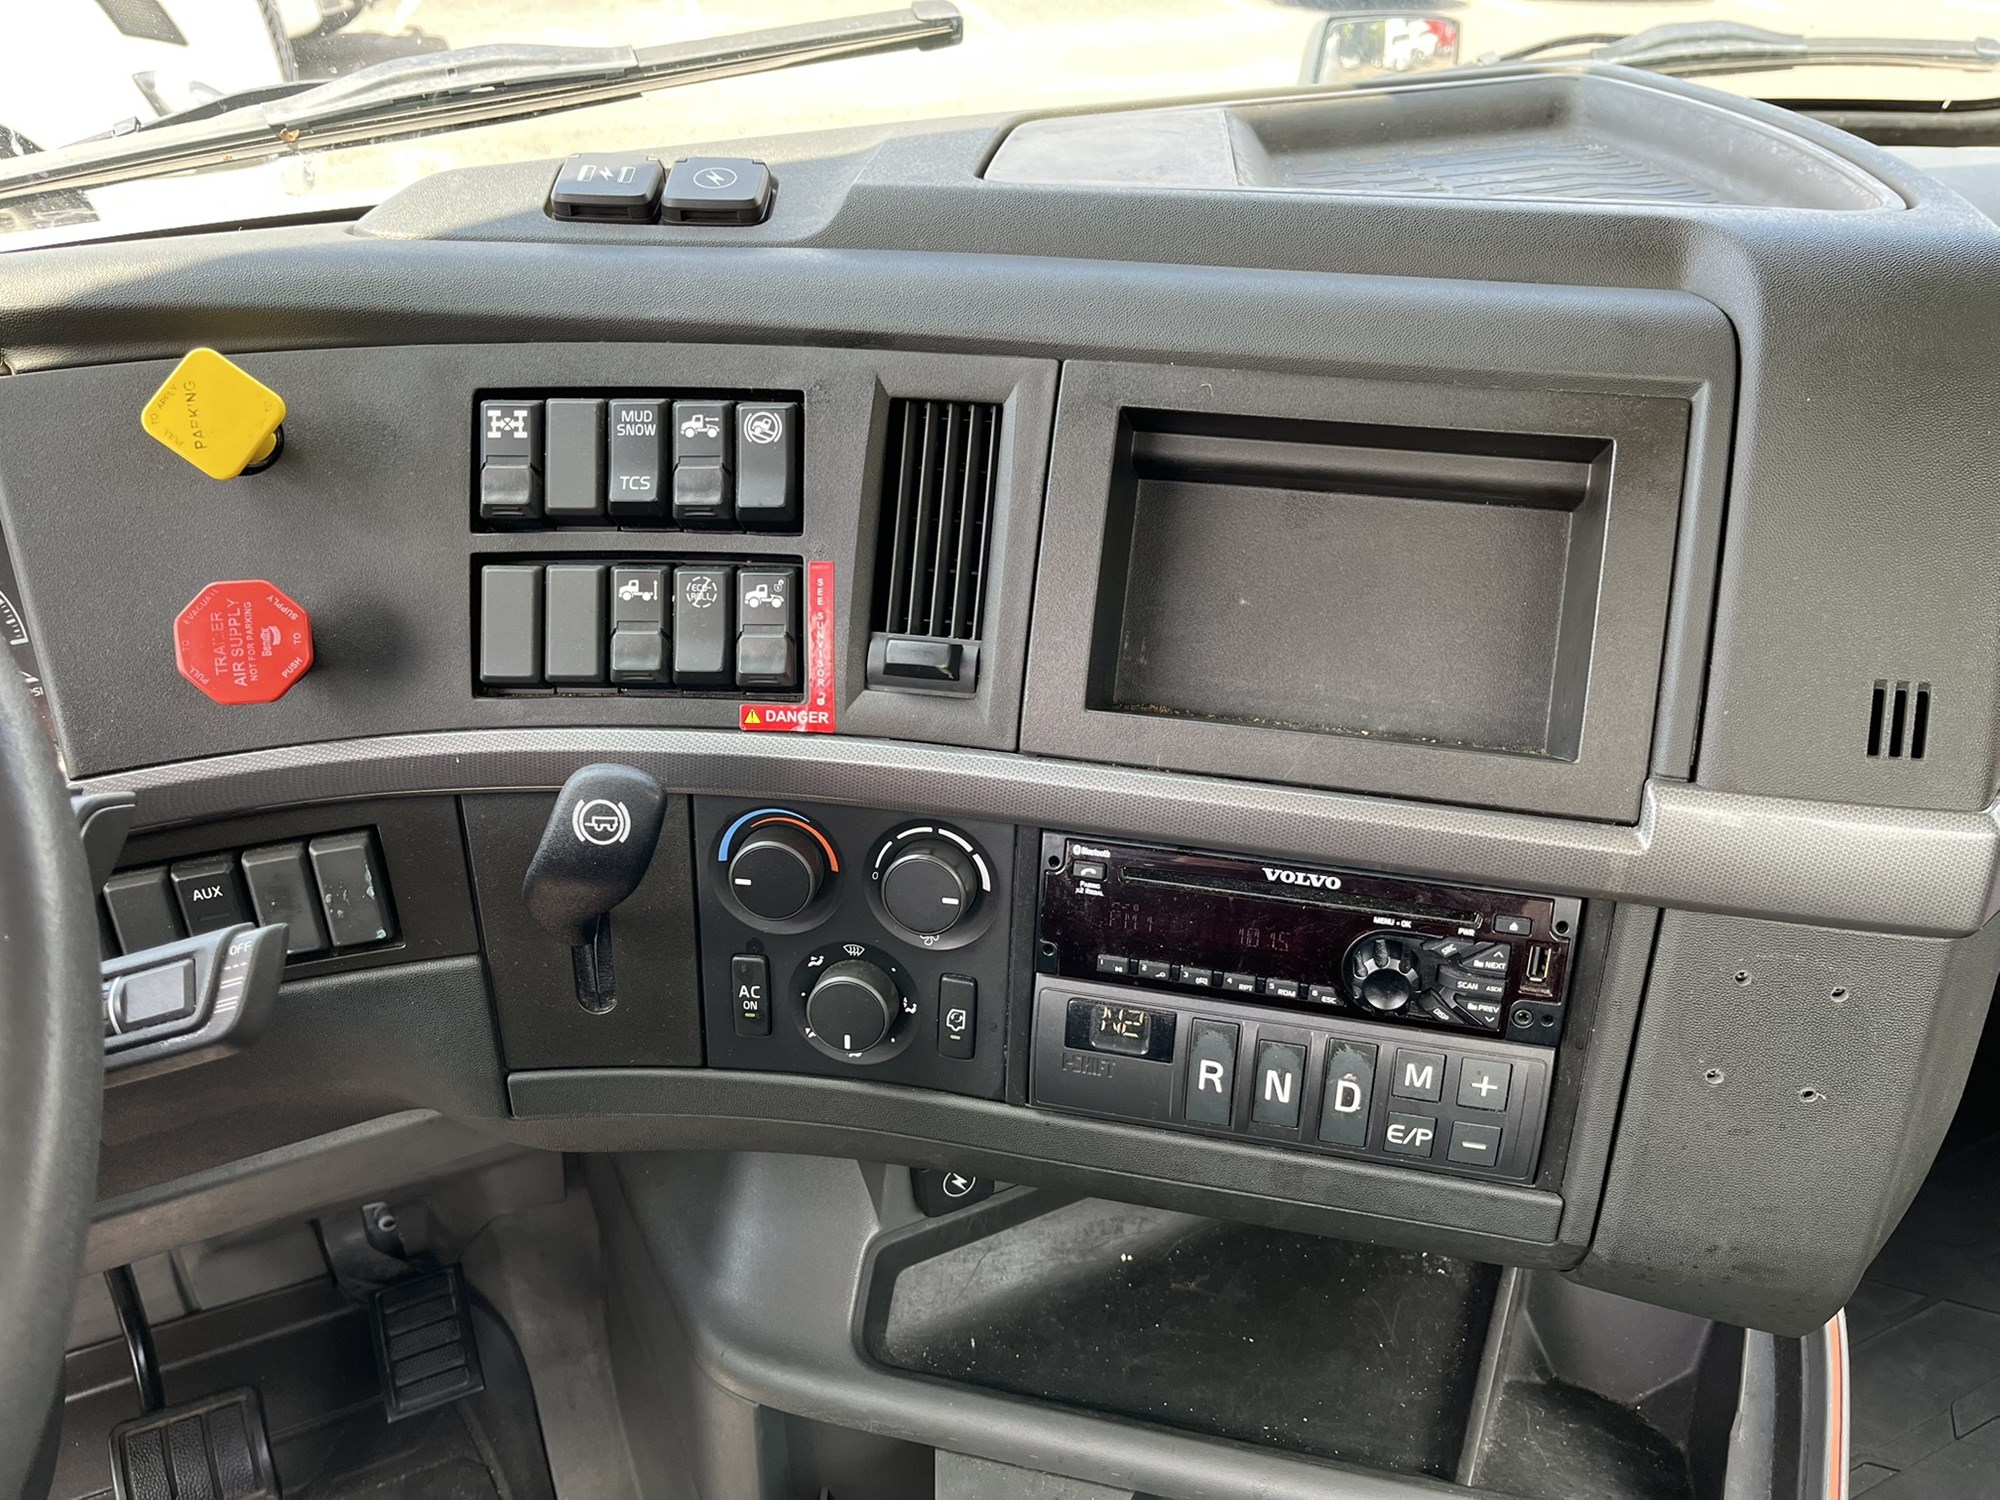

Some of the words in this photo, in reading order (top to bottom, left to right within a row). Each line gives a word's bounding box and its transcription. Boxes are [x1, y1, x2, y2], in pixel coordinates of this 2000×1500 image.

[621, 410, 653, 422] MUD
[616, 424, 657, 436] SNOW
[619, 475, 651, 490] TCS
[816, 577, 824, 606] SEE
[266, 594, 299, 621] SUPPLY
[226, 598, 244, 657] SUPPLY
[243, 601, 254, 641] PARKING
[210, 611, 229, 676] TRAER
[292, 632, 302, 645] TO
[246, 641, 256, 661] FOR
[816, 611, 825, 687] SUNVISOR
[190, 665, 210, 685] PULL
[232, 661, 248, 687] AIR
[248, 662, 259, 682] NOT
[281, 656, 303, 679] PUSH
[765, 710, 829, 724] DANGER
[1261, 867, 1342, 890] VOLVO
[192, 885, 224, 902] AUX
[1373, 916, 1395, 926] MENU
[1401, 919, 1412, 929] OK
[1457, 927, 1476, 937] PWR
[229, 940, 252, 956] OFF
[1440, 943, 1457, 956] SRC
[1484, 961, 1507, 970] NEXT
[738, 985, 761, 999] AC
[1238, 983, 1254, 993] RPT
[1457, 980, 1479, 990] SCAN
[742, 1001, 758, 1011] ON
[1478, 1003, 1500, 1014] PREV
[1197, 1058, 1225, 1093] R
[1403, 1062, 1433, 1090] M
[1264, 1069, 1292, 1104] N
[1334, 1079, 1362, 1113] D
[1386, 1123, 1433, 1147] E/P
